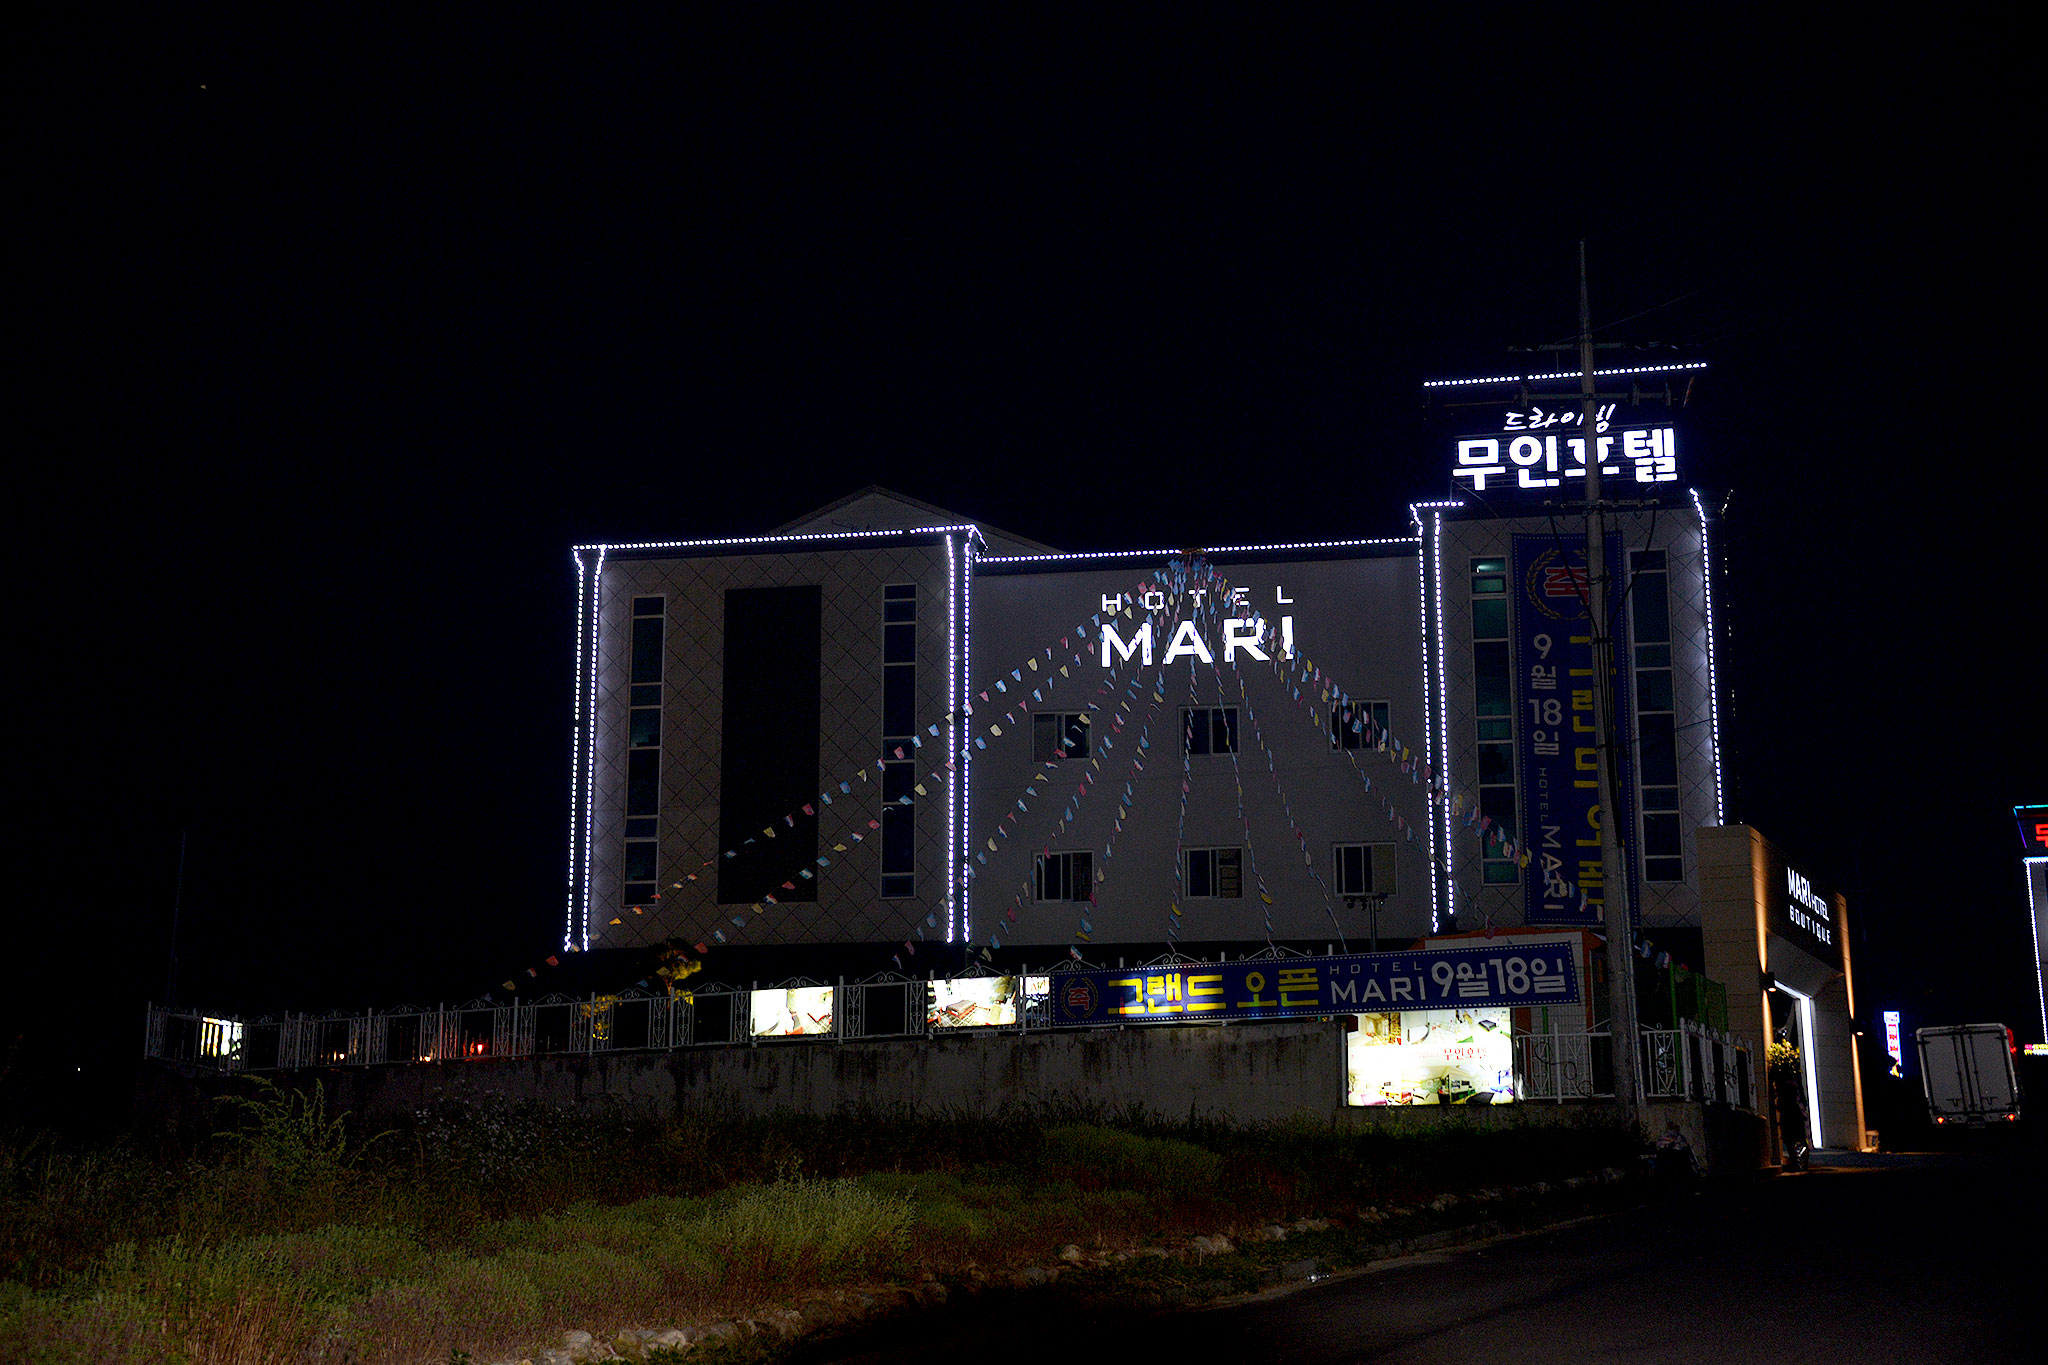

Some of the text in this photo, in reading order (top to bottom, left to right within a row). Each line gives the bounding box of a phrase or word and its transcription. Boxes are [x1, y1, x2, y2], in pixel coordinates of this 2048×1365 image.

[1452, 427, 1678, 491] 무인호텔
[1101, 585, 1295, 612] HOTEL
[1100, 615, 1295, 668] MARI
[1538, 767, 1549, 822] HOTEL
[1787, 866, 1812, 909] MARI
[1789, 904, 1832, 945] BOUTIQUE
[1329, 960, 1423, 975] HOTEL
[1067, 986, 1091, 1012] 축
[1107, 967, 1320, 1015] 그랜드 오픈
[1330, 976, 1427, 1005] MARI
